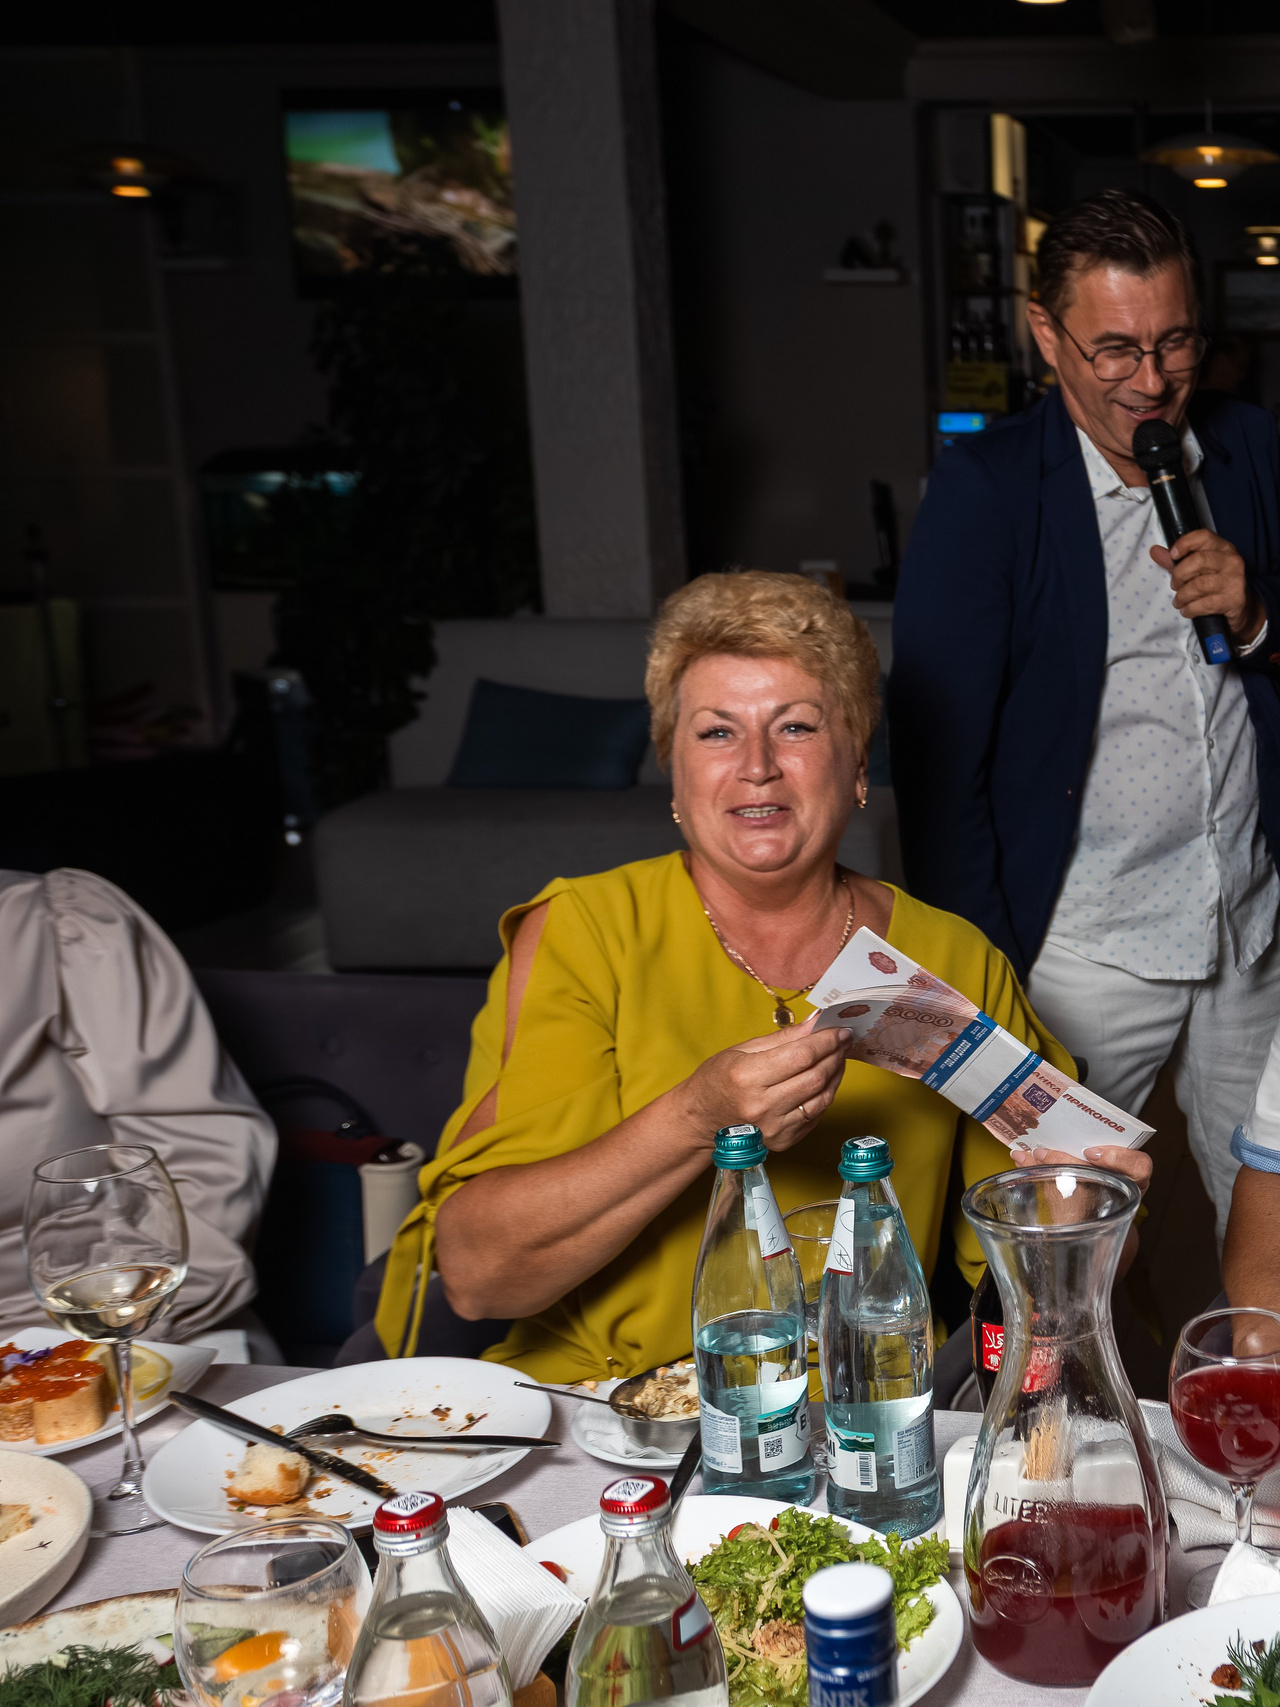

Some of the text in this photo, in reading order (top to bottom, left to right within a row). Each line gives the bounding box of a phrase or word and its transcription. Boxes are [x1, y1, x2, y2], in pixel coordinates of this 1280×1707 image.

[883, 1006, 954, 1027] 5000
[1033, 1071, 1126, 1134] АНКА ПРИКОЛОВ
